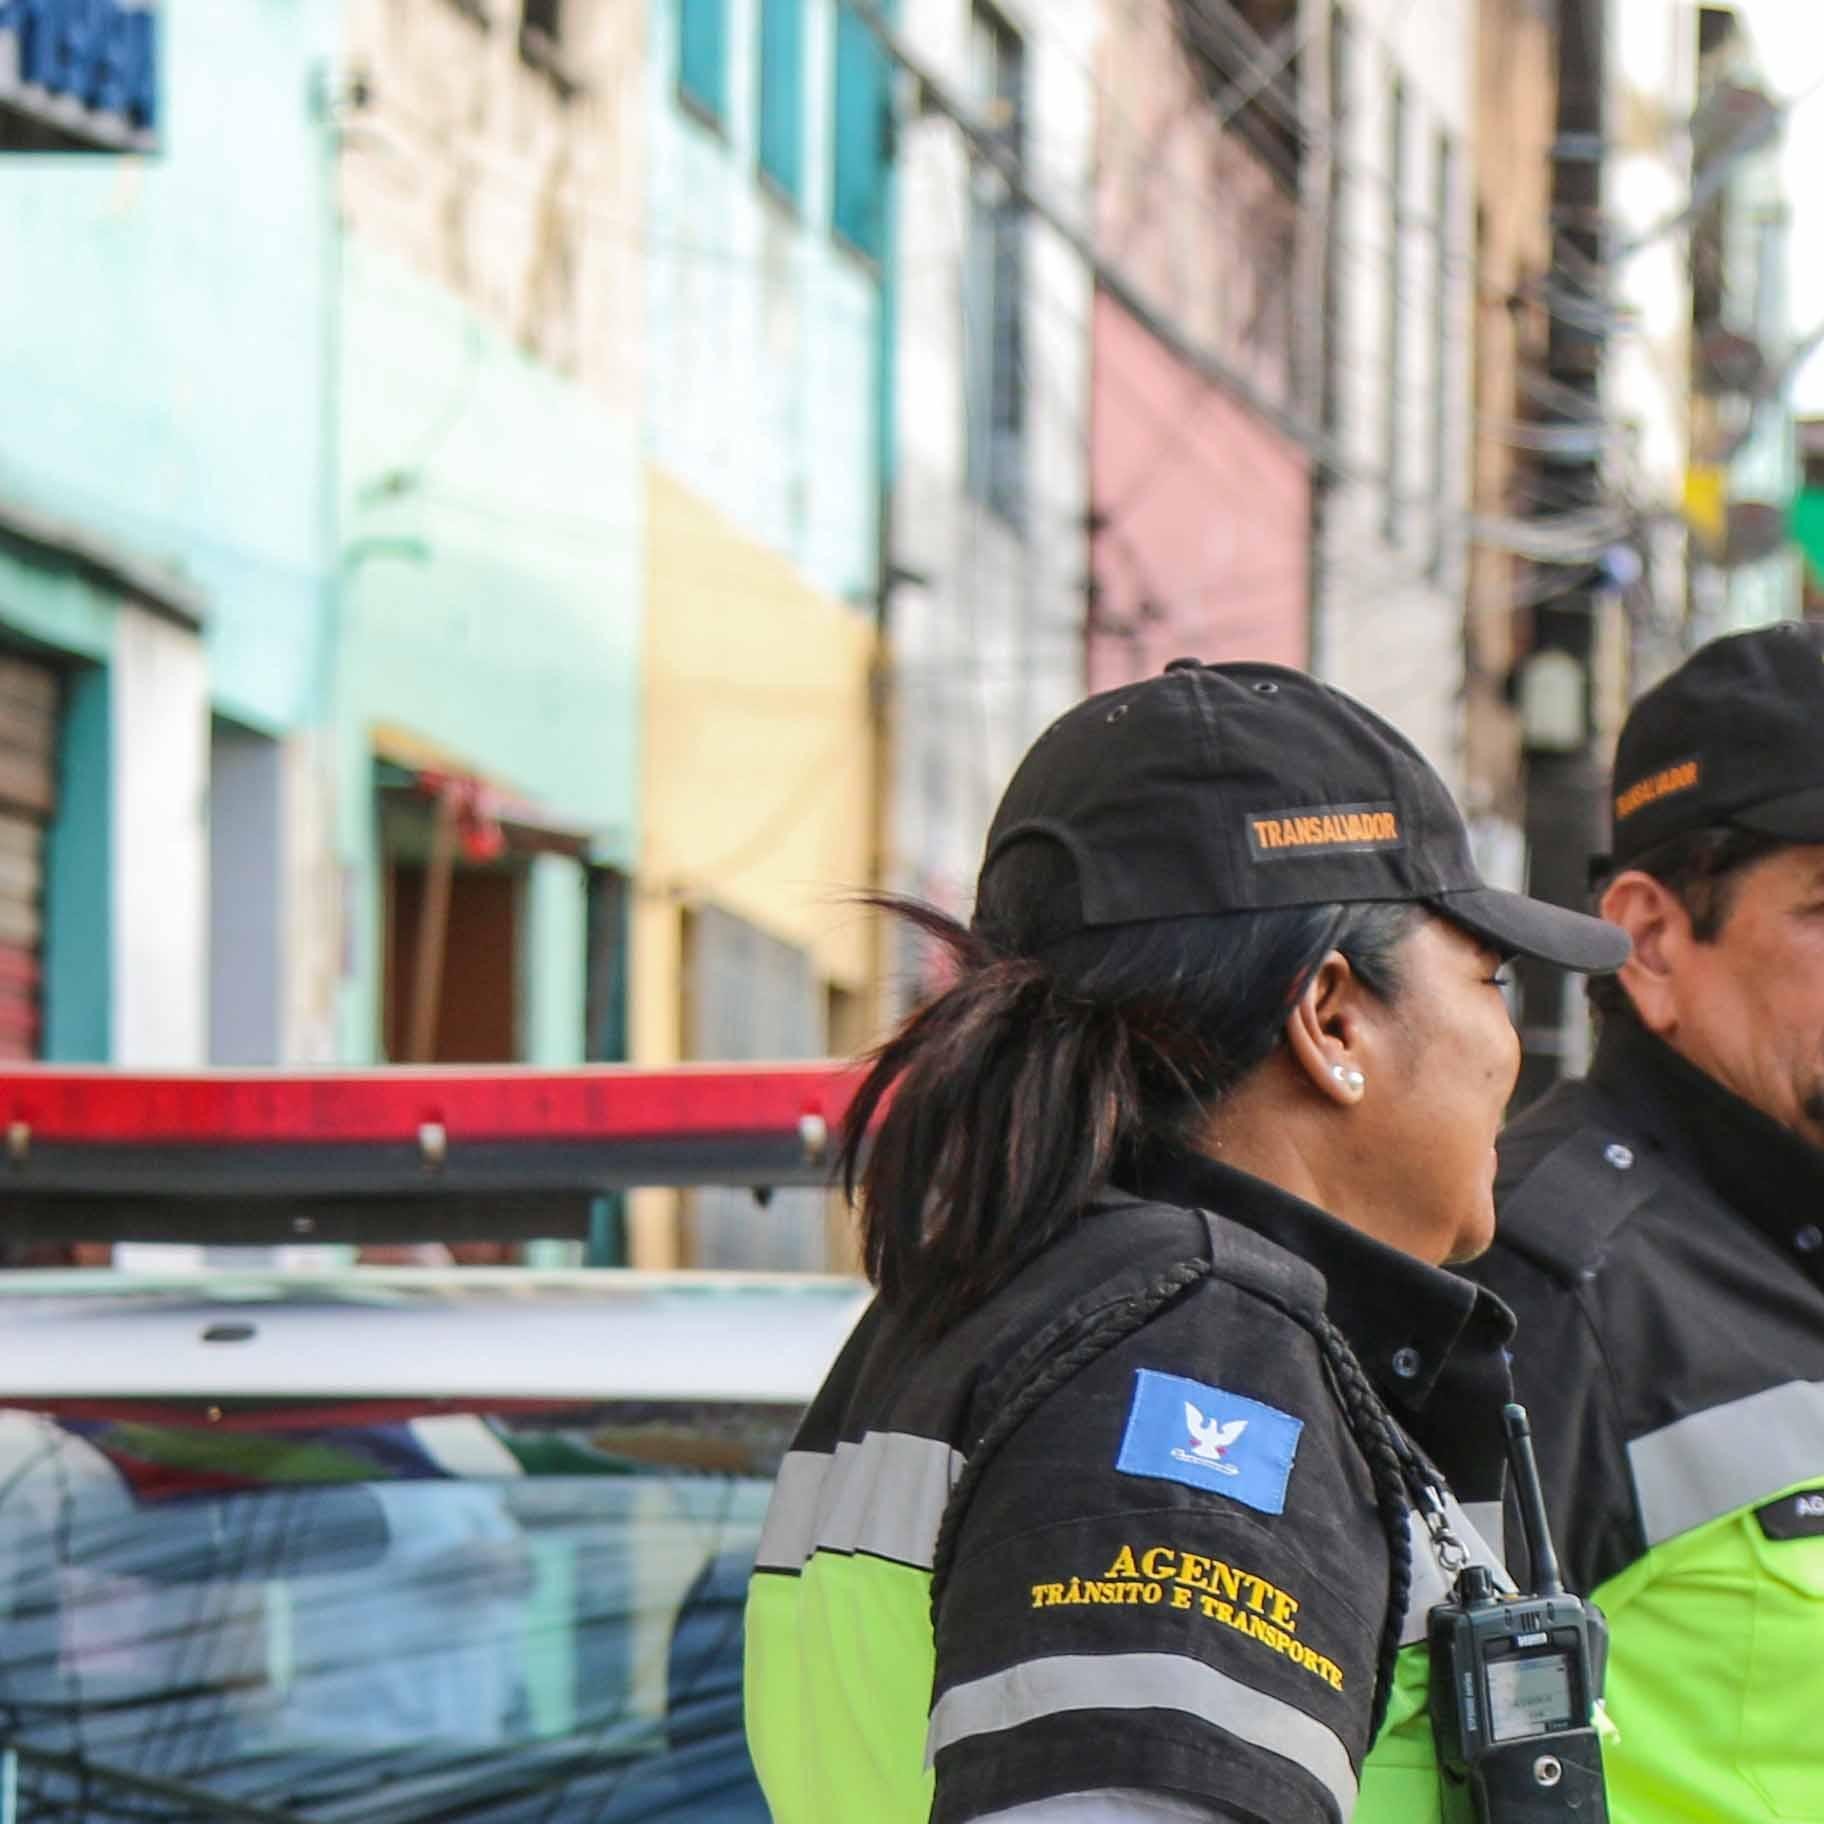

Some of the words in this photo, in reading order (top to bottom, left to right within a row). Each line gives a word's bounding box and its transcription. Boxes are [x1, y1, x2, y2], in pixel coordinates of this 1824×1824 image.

[1252, 811, 1399, 849] TRANSALVADOR
[1104, 1544, 1299, 1633] AGENTE
[1031, 1576, 1163, 1609] TRÂNSITO
[1170, 1585, 1192, 1610] E
[1200, 1595, 1345, 1692] TRANSPORTE
